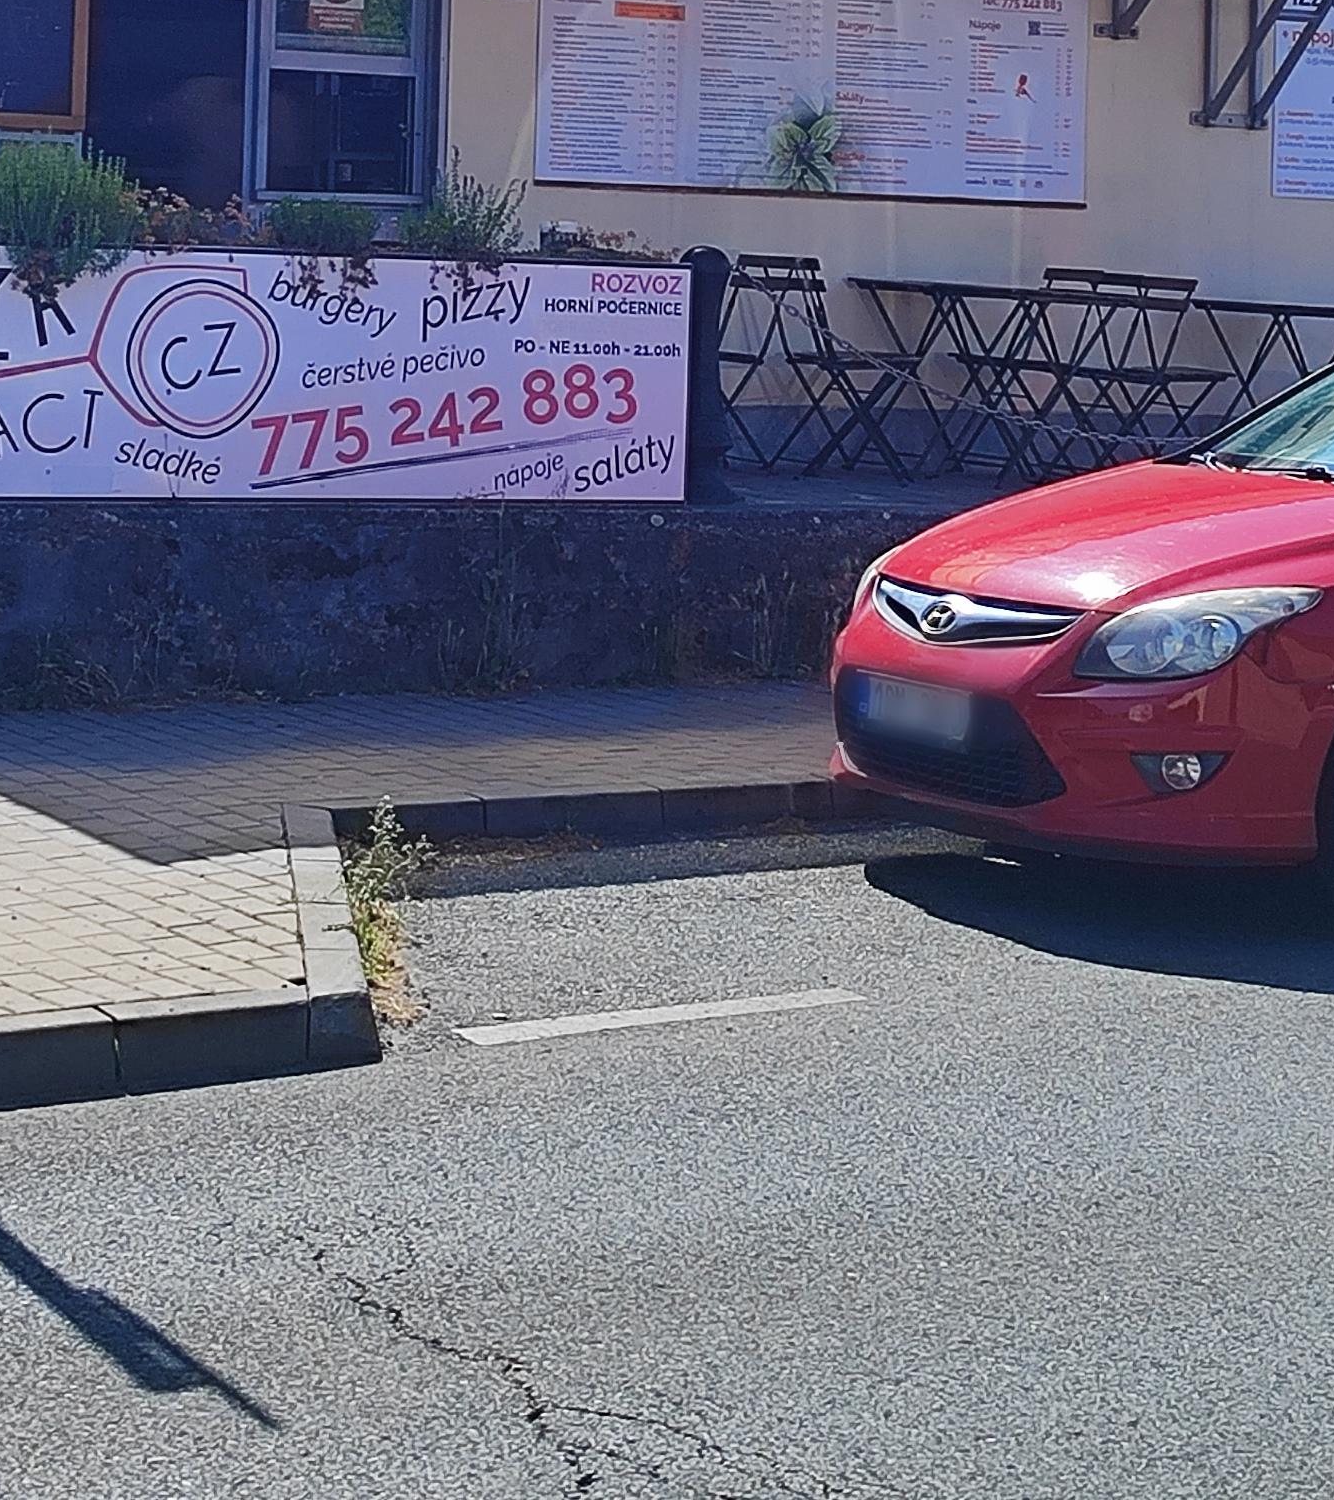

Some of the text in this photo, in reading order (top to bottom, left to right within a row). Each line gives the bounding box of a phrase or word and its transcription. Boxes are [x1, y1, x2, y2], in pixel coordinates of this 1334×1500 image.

[1023, 0, 1041, 10] 242
[1043, 0, 1063, 13] 883
[837, 20, 874, 34] Burgery
[1292, 29, 1334, 48] npoj
[591, 273, 683, 296] ROZVOZ
[267, 270, 397, 339] burgery
[421, 276, 531, 344] pizzy
[544, 296, 683, 317] HORNÍ POČERNICE
[301, 344, 486, 388] čerstvé pečivo
[514, 339, 536, 353] PO
[549, 340, 570, 354] NE
[573, 342, 621, 357] 11.00h
[633, 343, 681, 358] 21.00h
[251, 363, 638, 477] 775 242 883
[114, 437, 222, 485] sladké
[493, 453, 565, 491] nápoje
[574, 434, 676, 493] saláty
